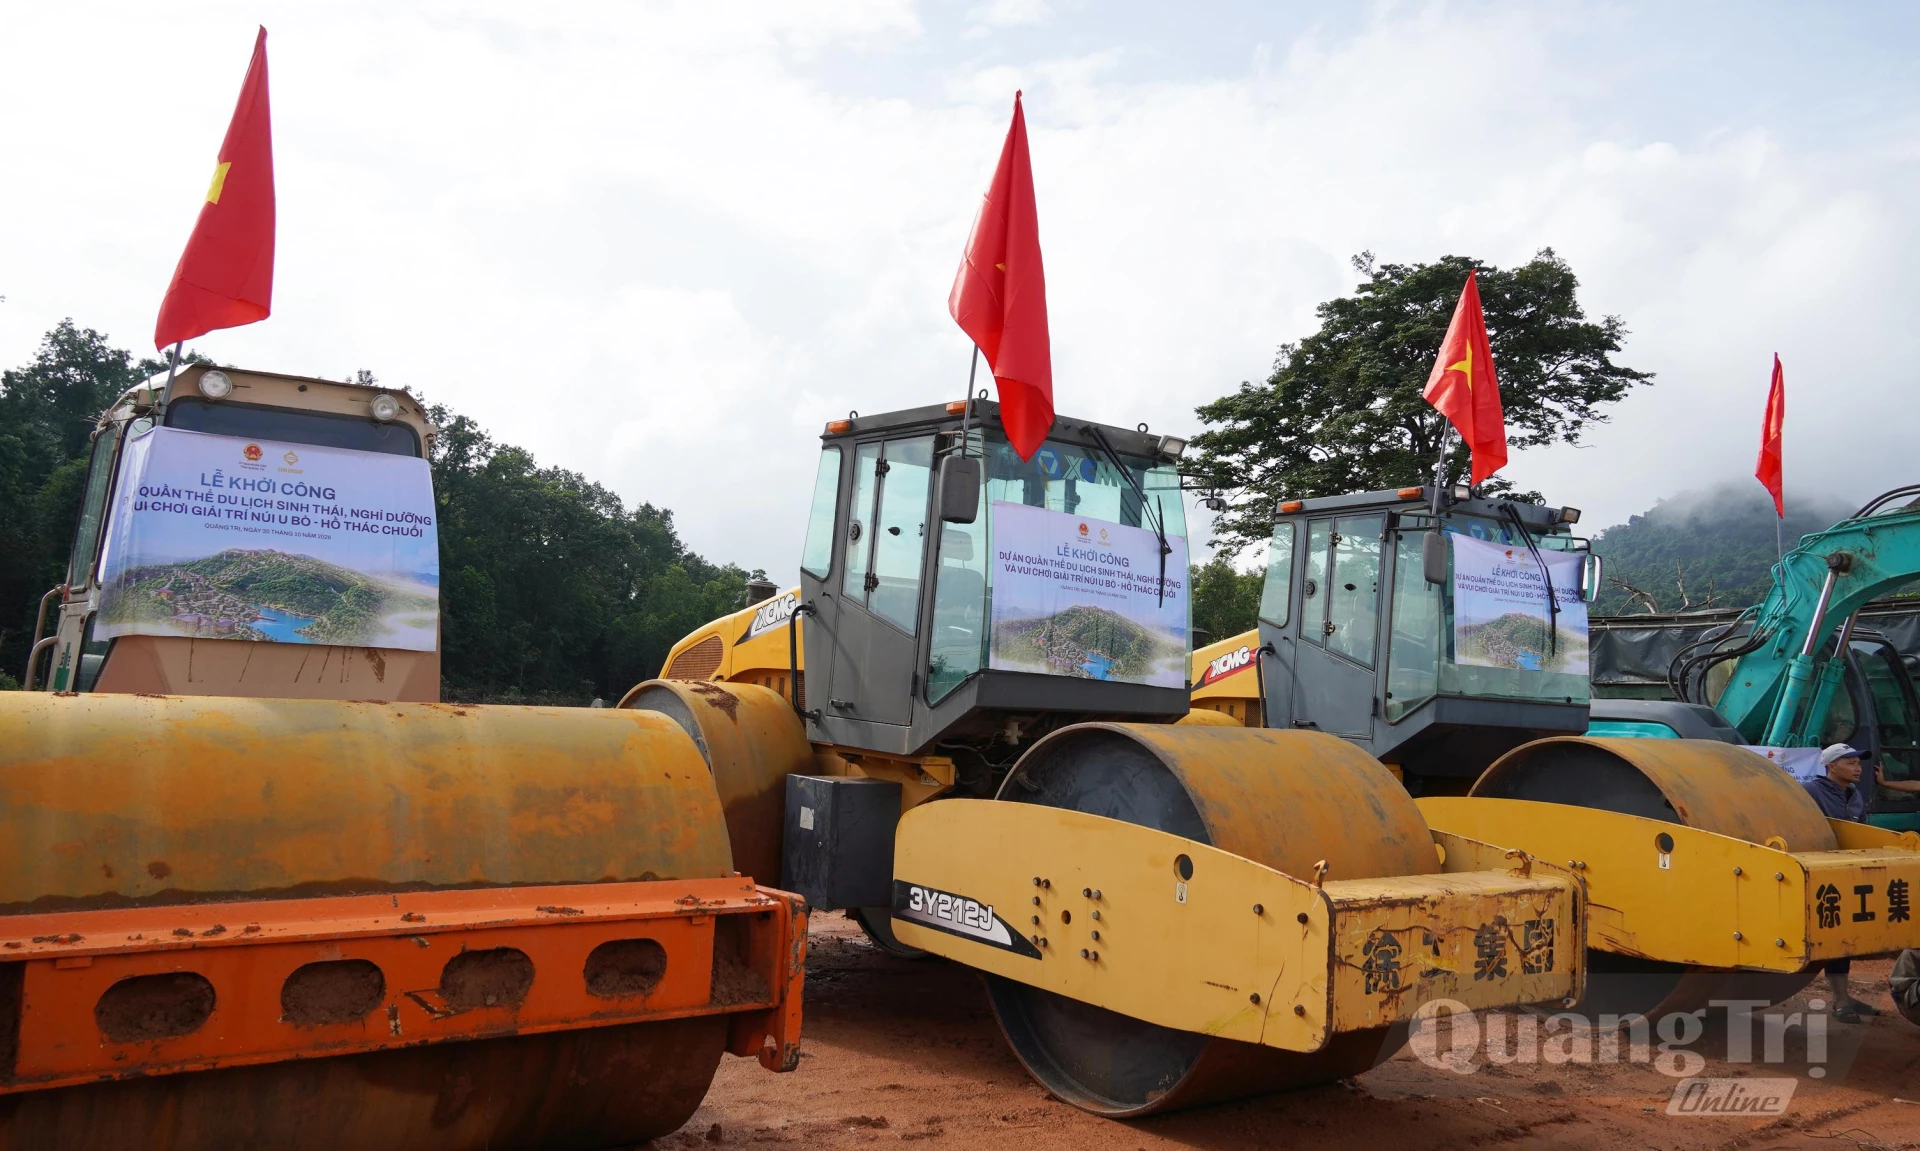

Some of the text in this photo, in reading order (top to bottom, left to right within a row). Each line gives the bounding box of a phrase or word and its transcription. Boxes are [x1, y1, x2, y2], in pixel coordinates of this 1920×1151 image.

[200, 468, 336, 500] LỄ KHỞI CÔNG
[134, 501, 147, 511] UI
[151, 501, 188, 514] CHƠI
[192, 506, 221, 518] GIẢI
[225, 507, 247, 520] TRÍ
[251, 508, 275, 523] NÚI
[278, 514, 288, 524] U
[291, 514, 311, 526] BÒ
[321, 517, 341, 530] HỒ
[343, 520, 379, 533] THÁC
[382, 524, 423, 538] CHUỐI
[139, 484, 432, 526] QUẦN THỂ DU LỊCH SINH THÁI, NGHỈ DƯỠNG
[999, 551, 1011, 562] DỰ
[1012, 551, 1023, 562] ÁN
[1025, 554, 1048, 566] QUẦN
[1050, 558, 1065, 569] THỂ
[1066, 562, 1077, 571] DU
[1080, 564, 1096, 574] LỊCH
[1098, 567, 1115, 577] SINH
[1117, 571, 1135, 582] THÁI,
[1137, 575, 1154, 584] NGHỈ
[1057, 542, 1129, 567] LỄ KHỞI CÔNG
[1005, 563, 1016, 573] VÀ
[1017, 566, 1031, 575] VUI
[1032, 568, 1052, 578] CHƠI
[1053, 571, 1069, 580] GIẢI
[1071, 573, 1083, 583] TRÍ
[1084, 576, 1097, 585] NÚI
[1105, 580, 1116, 588] BÒ
[1121, 582, 1132, 591] HỒ
[1133, 584, 1152, 595] THÁC
[1154, 588, 1176, 598] CUỐI
[1519, 570, 1541, 581] CÔNG
[1561, 587, 1579, 595] DƯỠN
[755, 593, 797, 632] XCMG
[1210, 646, 1250, 678] XCMG
[910, 887, 994, 931] 3Y212J
[1816, 878, 1910, 929] 徐工集
